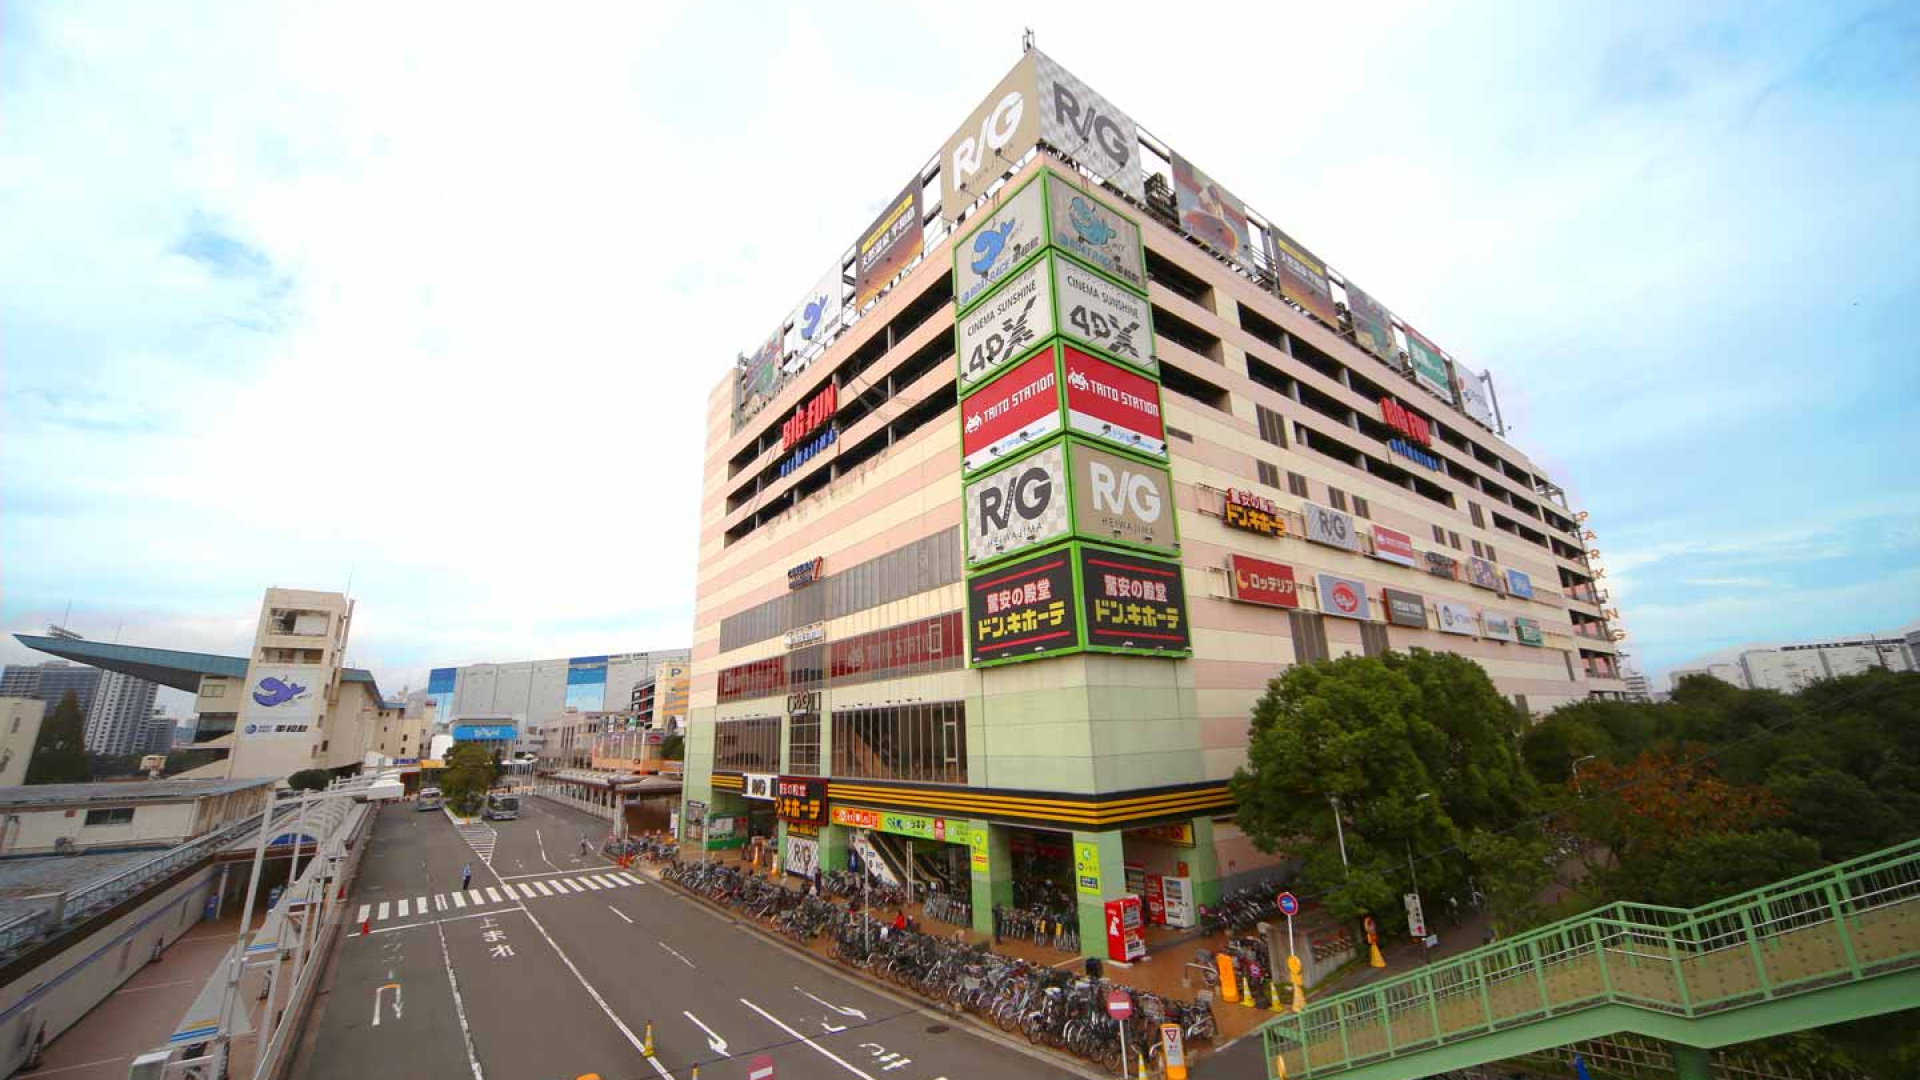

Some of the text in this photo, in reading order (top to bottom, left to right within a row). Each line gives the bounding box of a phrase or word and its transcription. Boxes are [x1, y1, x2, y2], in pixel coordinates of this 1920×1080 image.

[967, 279, 1037, 337] CINEMA SUNSHINE
[1067, 275, 1140, 319] CINEMA SUNSHINE
[968, 294, 1038, 373] 4DX
[1069, 304, 1141, 358] 4DX
[808, 383, 837, 433] FUN
[983, 371, 1055, 424] TAITO STATION
[1090, 380, 1160, 418] TAITO STATION
[1250, 574, 1294, 595] ロッテリア
